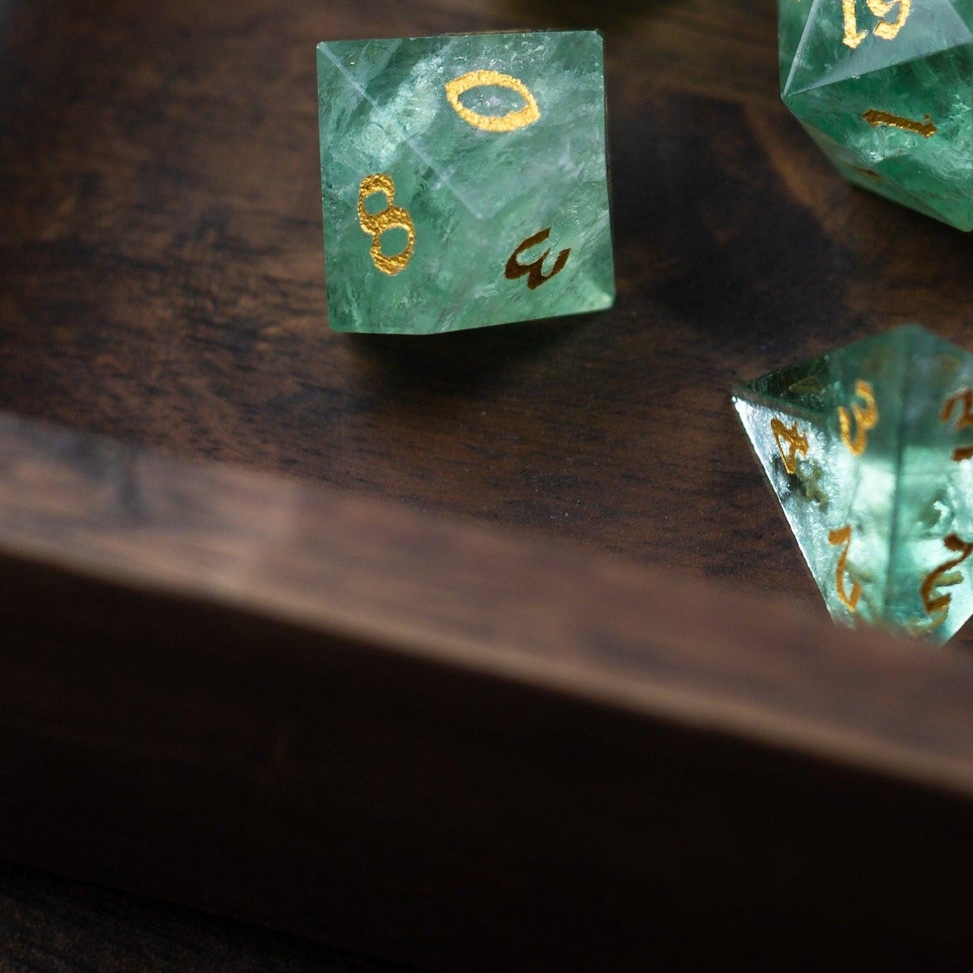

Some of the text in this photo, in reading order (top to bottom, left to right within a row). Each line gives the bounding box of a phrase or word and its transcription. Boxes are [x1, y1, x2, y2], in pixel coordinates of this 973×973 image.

[445, 69, 541, 134] 0
[862, 108, 937, 138] 1
[357, 173, 416, 276] 8
[504, 227, 572, 290] 3
[770, 416, 810, 475] 4
[837, 378, 880, 457] 3
[827, 524, 863, 611] 2
